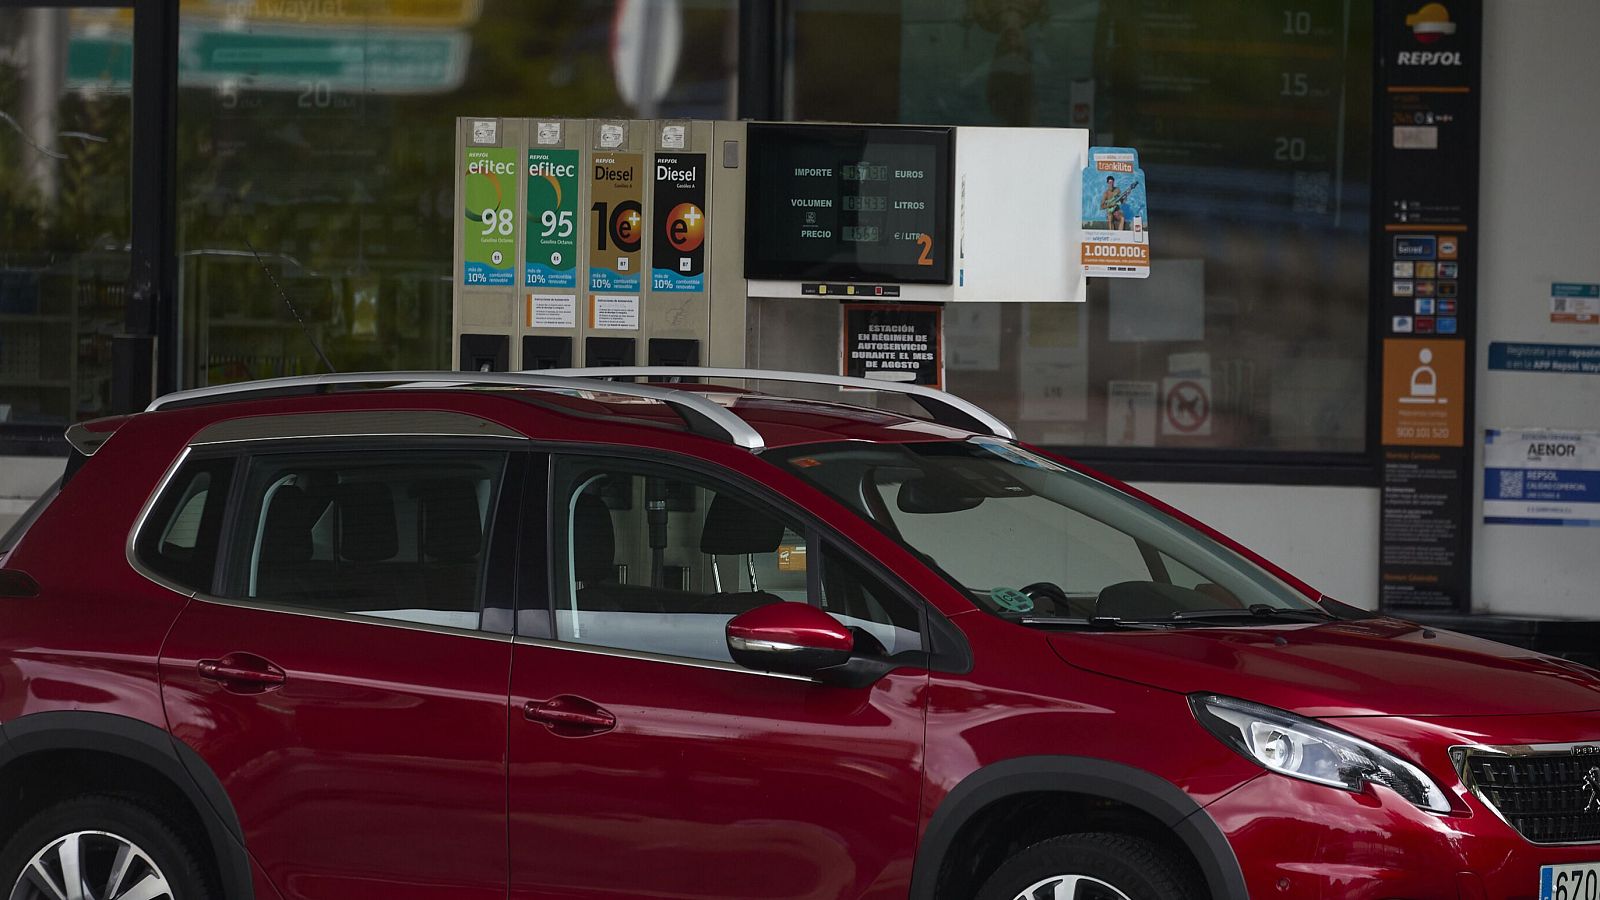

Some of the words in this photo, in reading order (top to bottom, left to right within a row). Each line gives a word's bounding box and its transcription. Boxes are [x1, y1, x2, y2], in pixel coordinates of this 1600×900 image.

[1282, 11, 1312, 34] 10
[1397, 51, 1462, 66] REPSOL
[1280, 72, 1308, 96] 15
[298, 80, 330, 109] 20
[1274, 136, 1306, 162] 20
[468, 160, 514, 174] efitec
[529, 162, 574, 177] efitec
[595, 166, 633, 180] Diesel
[657, 166, 696, 181] Diesel
[794, 168, 832, 177] IMPORTE
[894, 170, 924, 178] EUROS
[791, 199, 832, 207] VOLUMEN
[894, 201, 925, 209] LITROS
[481, 208, 514, 235] 98
[541, 210, 573, 237] 95
[916, 234, 933, 265] 2
[1085, 245, 1146, 258] 1.000.000€
[468, 273, 486, 283] 10%
[528, 274, 546, 283] 10%
[592, 280, 611, 289] 10%
[654, 280, 673, 289] 10%
[868, 324, 915, 333] ESTACIÓN
[872, 333, 913, 342] RÉGIMEN
[858, 342, 928, 351] AUTOSERVICIO
[1528, 444, 1576, 457] AENOR
[1526, 471, 1558, 481] REPSOL
